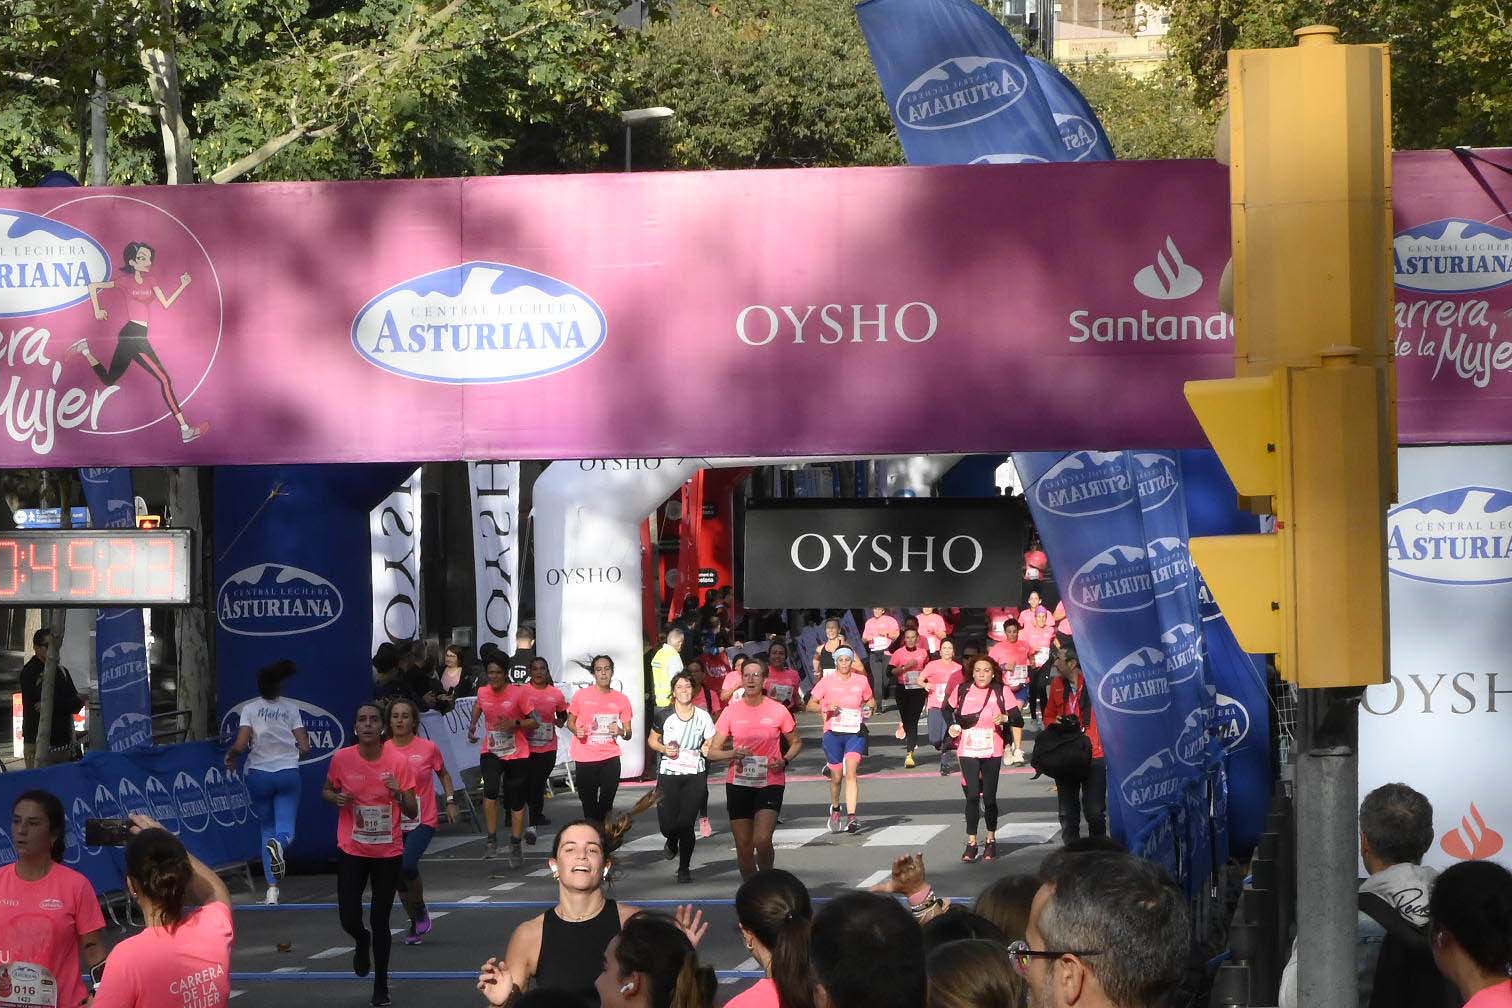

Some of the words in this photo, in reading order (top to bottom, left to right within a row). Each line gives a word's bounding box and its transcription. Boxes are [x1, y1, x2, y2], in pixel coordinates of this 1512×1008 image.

[15, 245, 86, 256] LECHERA
[1465, 243, 1511, 252] LECHER
[411, 304, 488, 319] CENTRAL
[497, 302, 579, 316] LECHERA
[735, 301, 939, 346] OYSHO
[1395, 299, 1489, 329] arrera
[371, 309, 588, 354] ASTURIANA
[1069, 309, 1235, 343] Santand
[1417, 330, 1435, 357] la
[1431, 322, 1512, 388] Muje
[1415, 521, 1482, 532] CENTRAL
[790, 532, 984, 574] OYSHO
[1388, 525, 1512, 562] ASTURI
[546, 566, 622, 586] OYSHO
[221, 592, 334, 620] ASTURIANA
[514, 670, 526, 678] BP
[1360, 672, 1512, 717] OYSH
[14, 985, 36, 996] 016
[169, 963, 225, 995] CARRERA
[183, 990, 198, 1004] DE
[202, 981, 218, 996] LA
